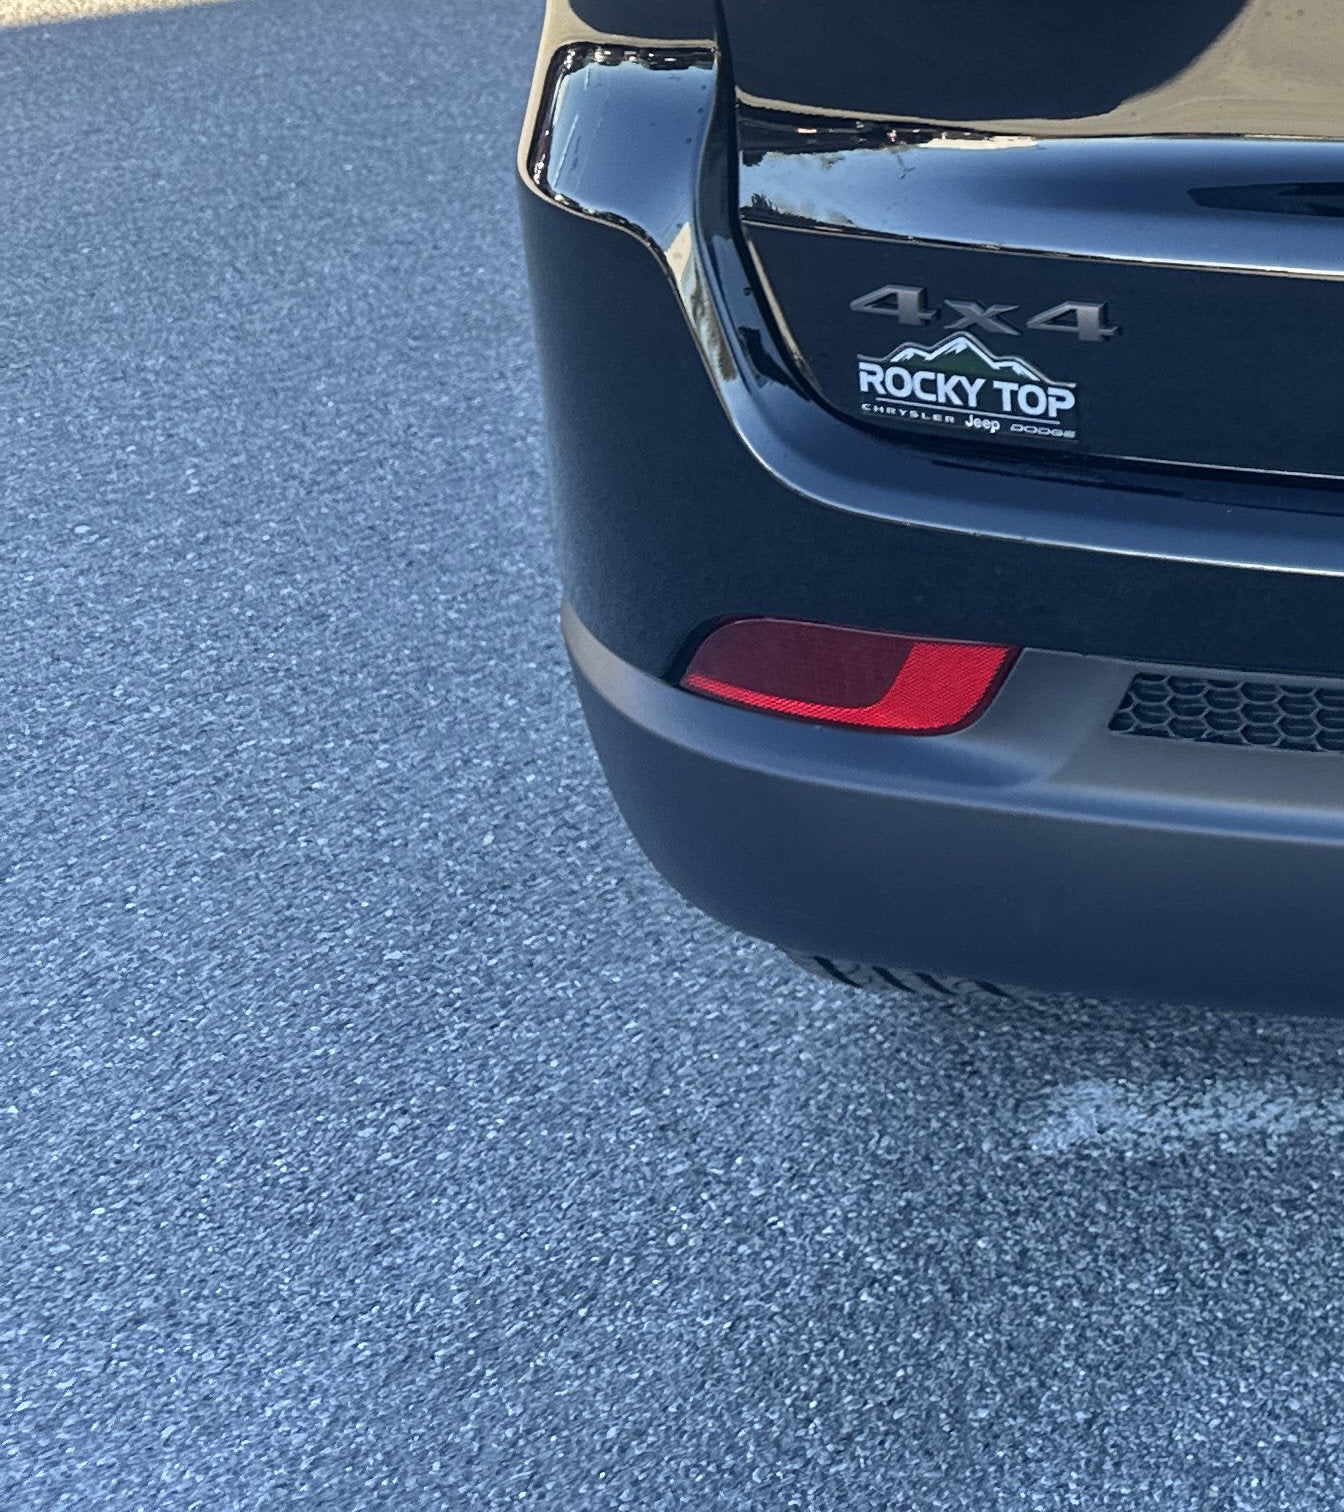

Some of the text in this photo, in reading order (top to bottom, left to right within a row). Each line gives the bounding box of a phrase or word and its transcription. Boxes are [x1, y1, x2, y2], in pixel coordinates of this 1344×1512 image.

[858, 361, 1076, 418] ROCKY TOP
[860, 403, 1076, 439] CHRYSLER Jeep DODGE
